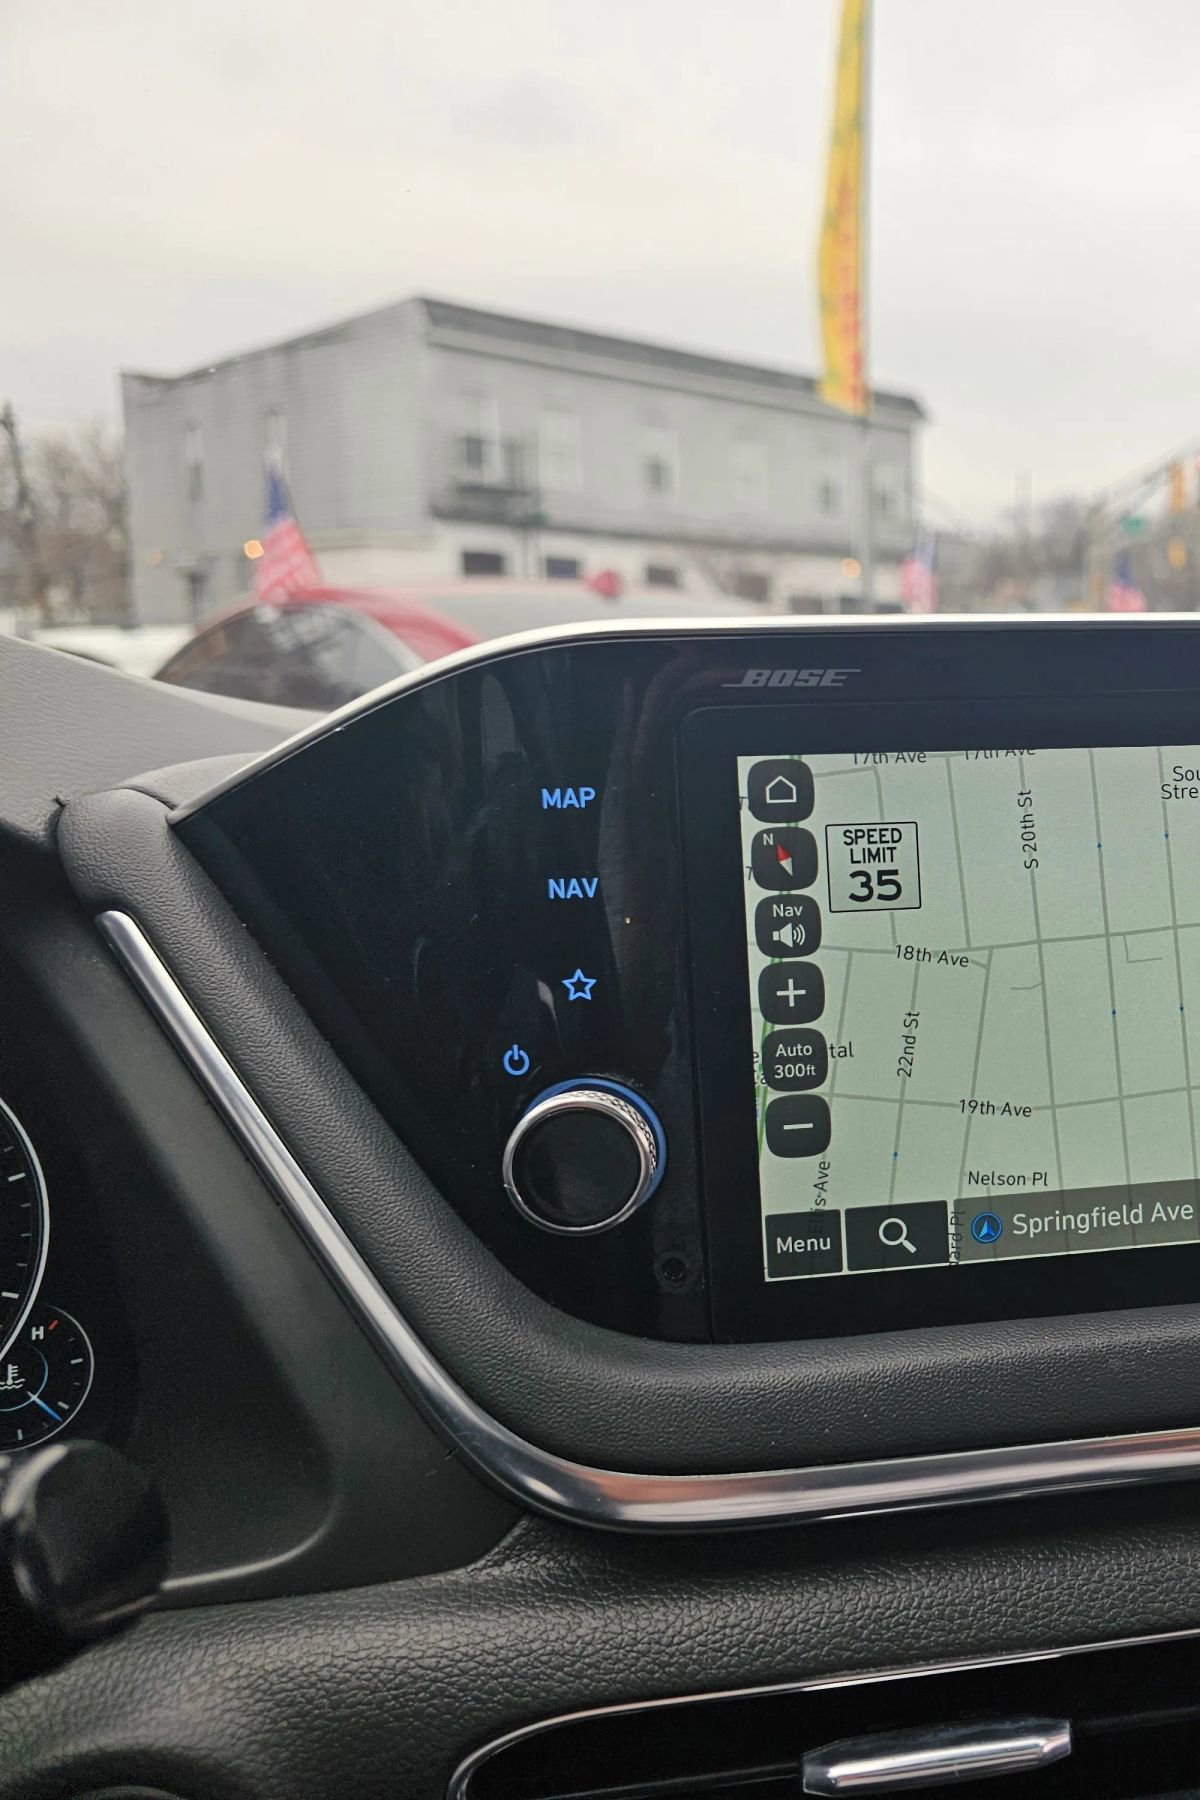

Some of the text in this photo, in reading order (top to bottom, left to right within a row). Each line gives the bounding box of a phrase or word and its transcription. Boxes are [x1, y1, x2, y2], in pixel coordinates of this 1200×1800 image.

[722, 668, 861, 688] BOSE
[895, 751, 927, 763] Ave
[541, 786, 597, 810] MAP
[842, 827, 902, 846] SPEED
[1017, 789, 1039, 870] S 20th St
[763, 833, 774, 846] N
[850, 847, 896, 865] LIMIT
[547, 877, 598, 900] NAV
[848, 869, 902, 902] 35
[772, 903, 804, 918] Nav
[895, 945, 970, 968] 18th Ave
[776, 1043, 813, 1058] Auto
[896, 1011, 920, 1078] 22nd St
[774, 1062, 817, 1079] 300ft
[958, 1098, 1033, 1118] 19th Ave
[814, 1161, 832, 1193] Ave
[967, 1169, 1049, 1188] Nelson Pl
[1012, 1202, 1195, 1238] Springfield Ave
[776, 1235, 832, 1254] Menu
[31, 1325, 45, 1341] H
